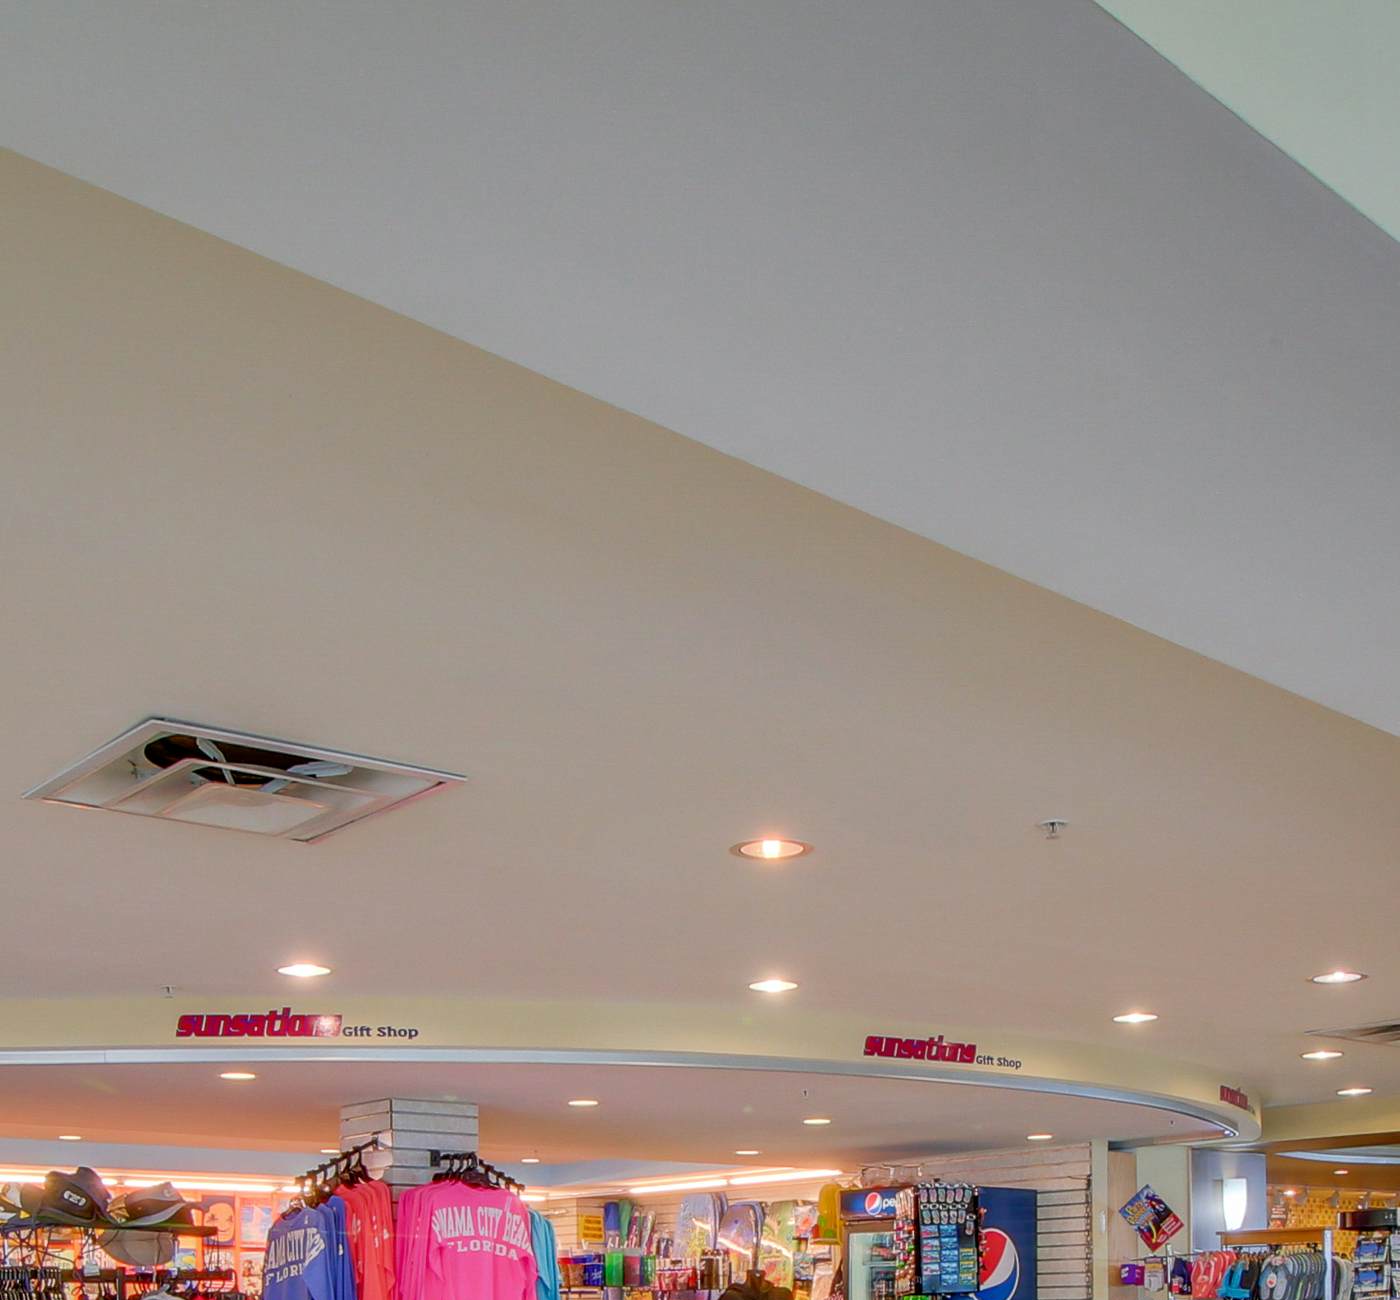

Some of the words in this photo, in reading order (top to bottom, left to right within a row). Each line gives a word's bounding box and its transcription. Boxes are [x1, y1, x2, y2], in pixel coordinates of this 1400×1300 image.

[342, 1026, 372, 1037] Gift
[377, 1026, 418, 1039] Shop
[864, 1035, 976, 1063] sunsations
[976, 1055, 994, 1066] Gift
[997, 1057, 1022, 1070] Shop
[477, 1206, 503, 1239] CITY
